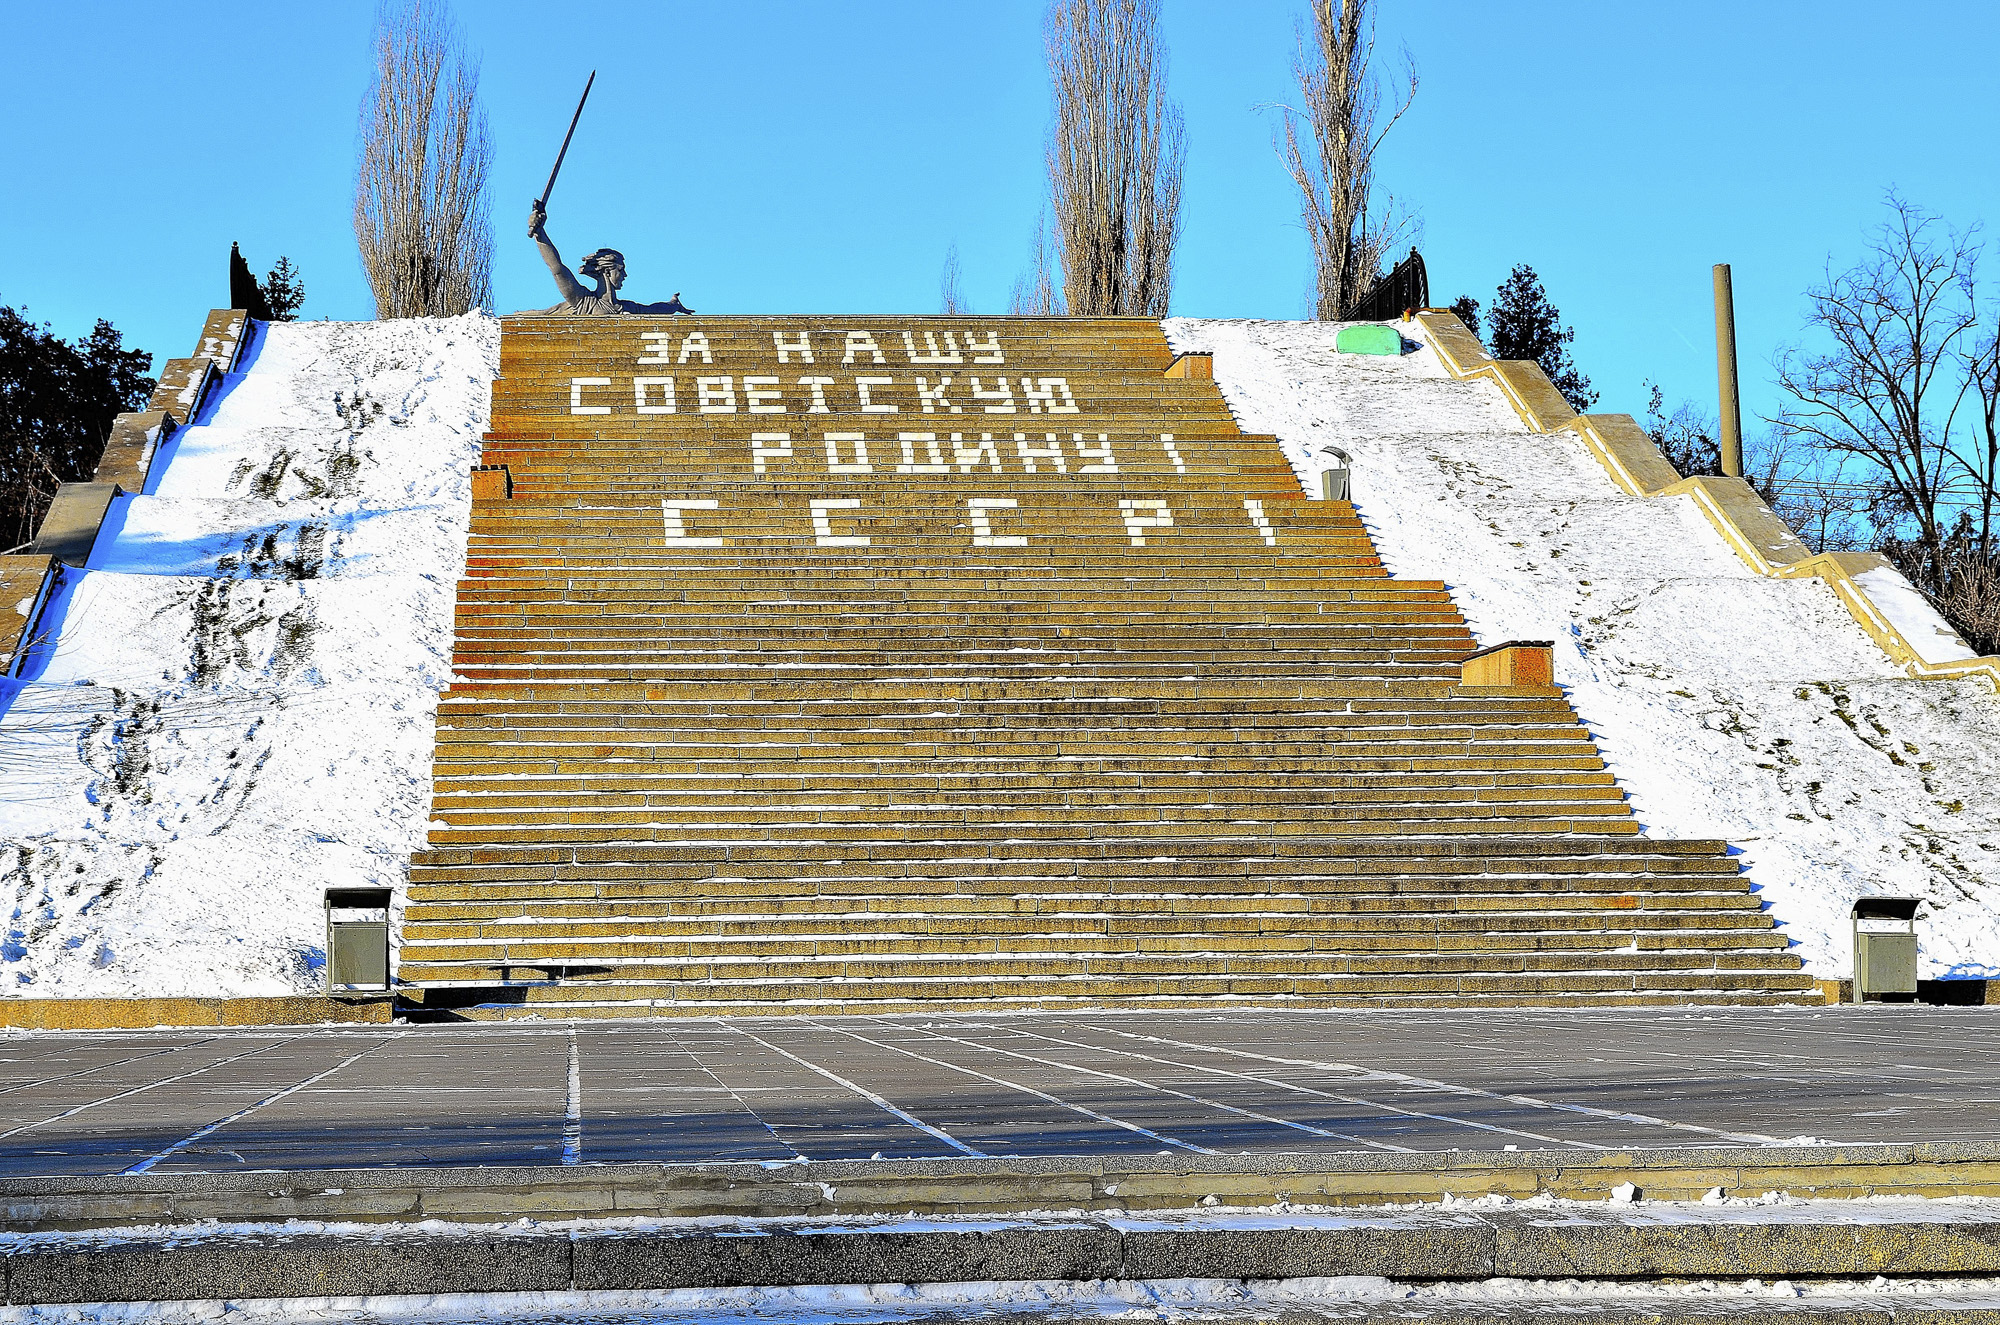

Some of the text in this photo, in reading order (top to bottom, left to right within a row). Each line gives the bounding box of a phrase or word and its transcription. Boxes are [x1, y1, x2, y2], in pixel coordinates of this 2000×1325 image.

[637, 331, 1005, 364] ЗА НАШУ
[570, 376, 1080, 414] СОВЕТСКУЮ
